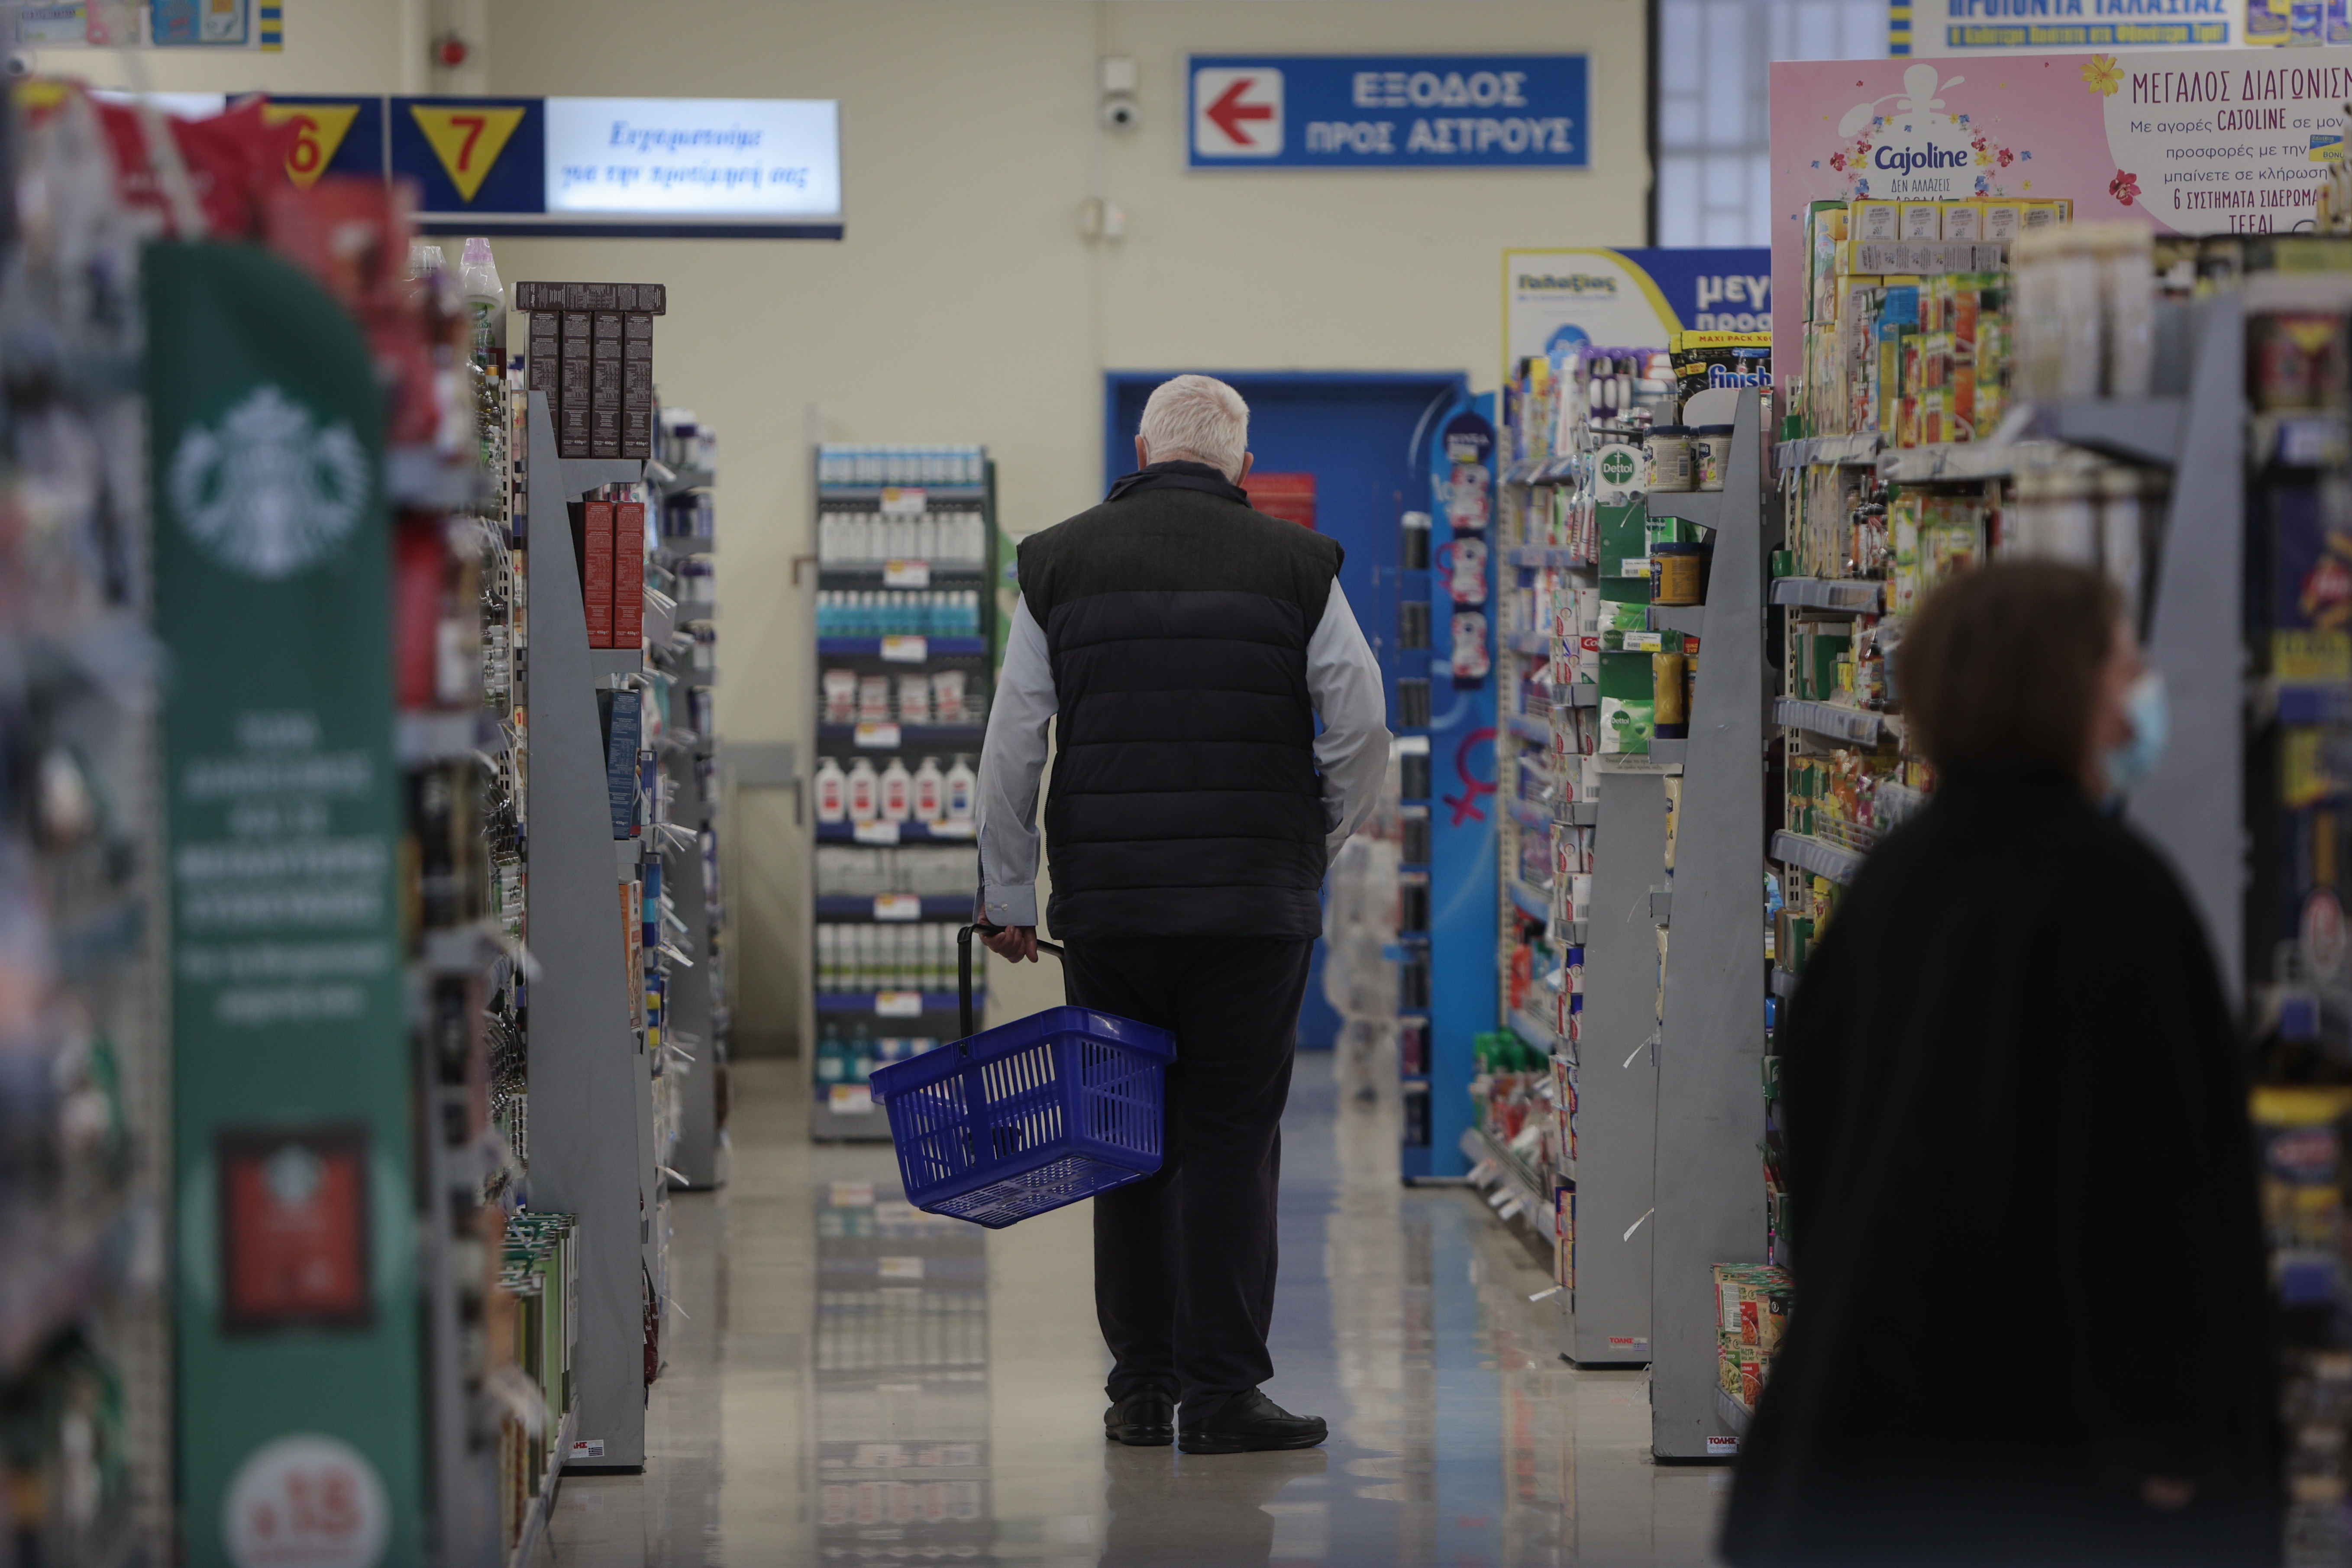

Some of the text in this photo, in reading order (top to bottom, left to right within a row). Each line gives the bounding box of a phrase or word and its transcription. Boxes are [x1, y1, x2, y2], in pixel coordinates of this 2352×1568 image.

[1353, 71, 1528, 108] ΕΞΟΔΟΣ
[2133, 71, 2230, 104] ΜΕΓΑΛΟΣ
[2131, 108, 2343, 134] Με αγορές CAJOLINE σε μον
[287, 115, 320, 172] 6
[450, 116, 486, 171] 7
[1306, 116, 1574, 154] ΠΡΟΣ ΑΣΤΡΟΥΣ
[1875, 142, 1967, 175] Cajoline
[2166, 144, 2307, 160] προσφορές με την
[1891, 178, 1951, 193] ΔΕΝ ΑΛΛΑΖΕΙΣ
[2165, 166, 2328, 184] μπαίνετε σε κλήρωση
[2174, 188, 2180, 210] 6
[2187, 191, 2255, 209] ΣΥΣΤΗΜΑΤΑ
[1696, 275, 1771, 310] μεγ
[1710, 364, 1772, 388] finish
[1603, 462, 1633, 473] Dettol
[1612, 717, 1630, 725] Dettol
